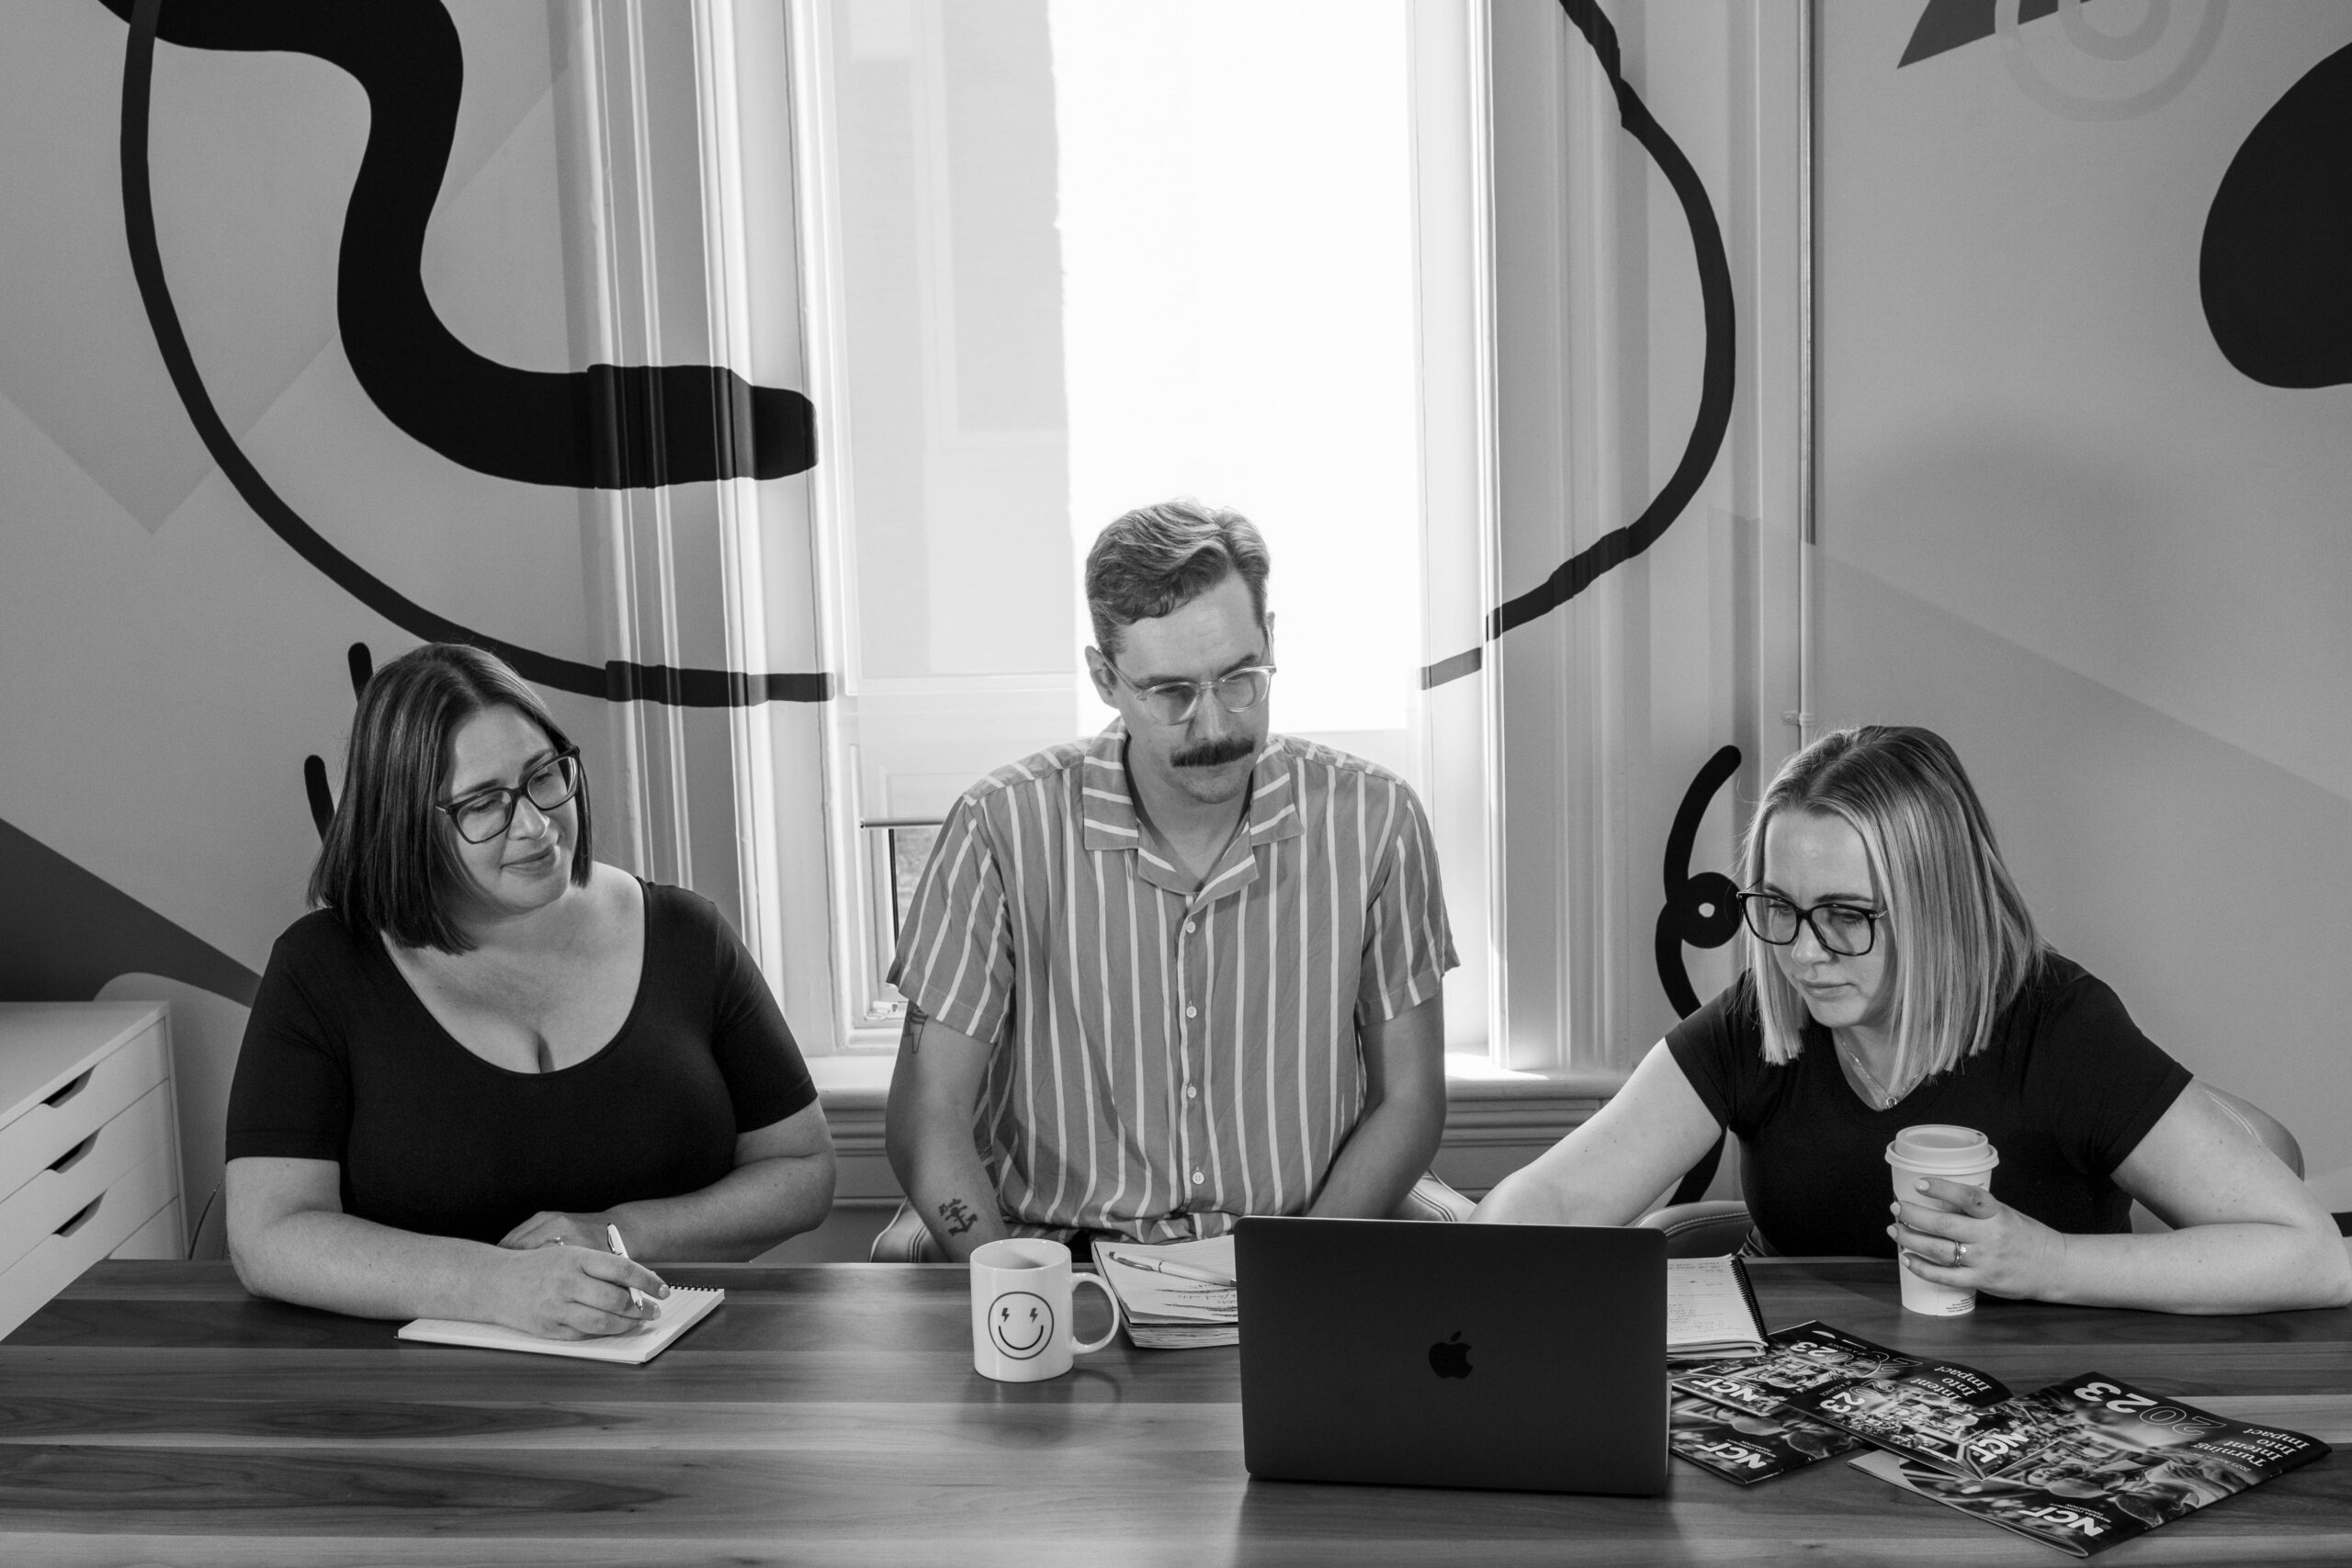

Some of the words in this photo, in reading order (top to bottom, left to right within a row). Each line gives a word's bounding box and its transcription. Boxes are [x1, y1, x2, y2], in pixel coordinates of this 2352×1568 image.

[1789, 1341, 1876, 1369] 2023
[1690, 1378, 1760, 1403] NCF
[1910, 1377, 1962, 1401] Intent
[1933, 1366, 1992, 1393] Impact
[1941, 1377, 1977, 1397] Into
[1819, 1378, 1894, 1414] 2023
[2073, 1382, 2227, 1437] 2023
[1968, 1431, 2030, 1463] NCF
[2222, 1439, 2283, 1461] Intent
[2243, 1428, 2311, 1450] Impact
[2256, 1438, 2297, 1456] Into
[1693, 1442, 1768, 1469] NCF
[2189, 1441, 2267, 1467] Turning
[2018, 1506, 2105, 1537] NCF
